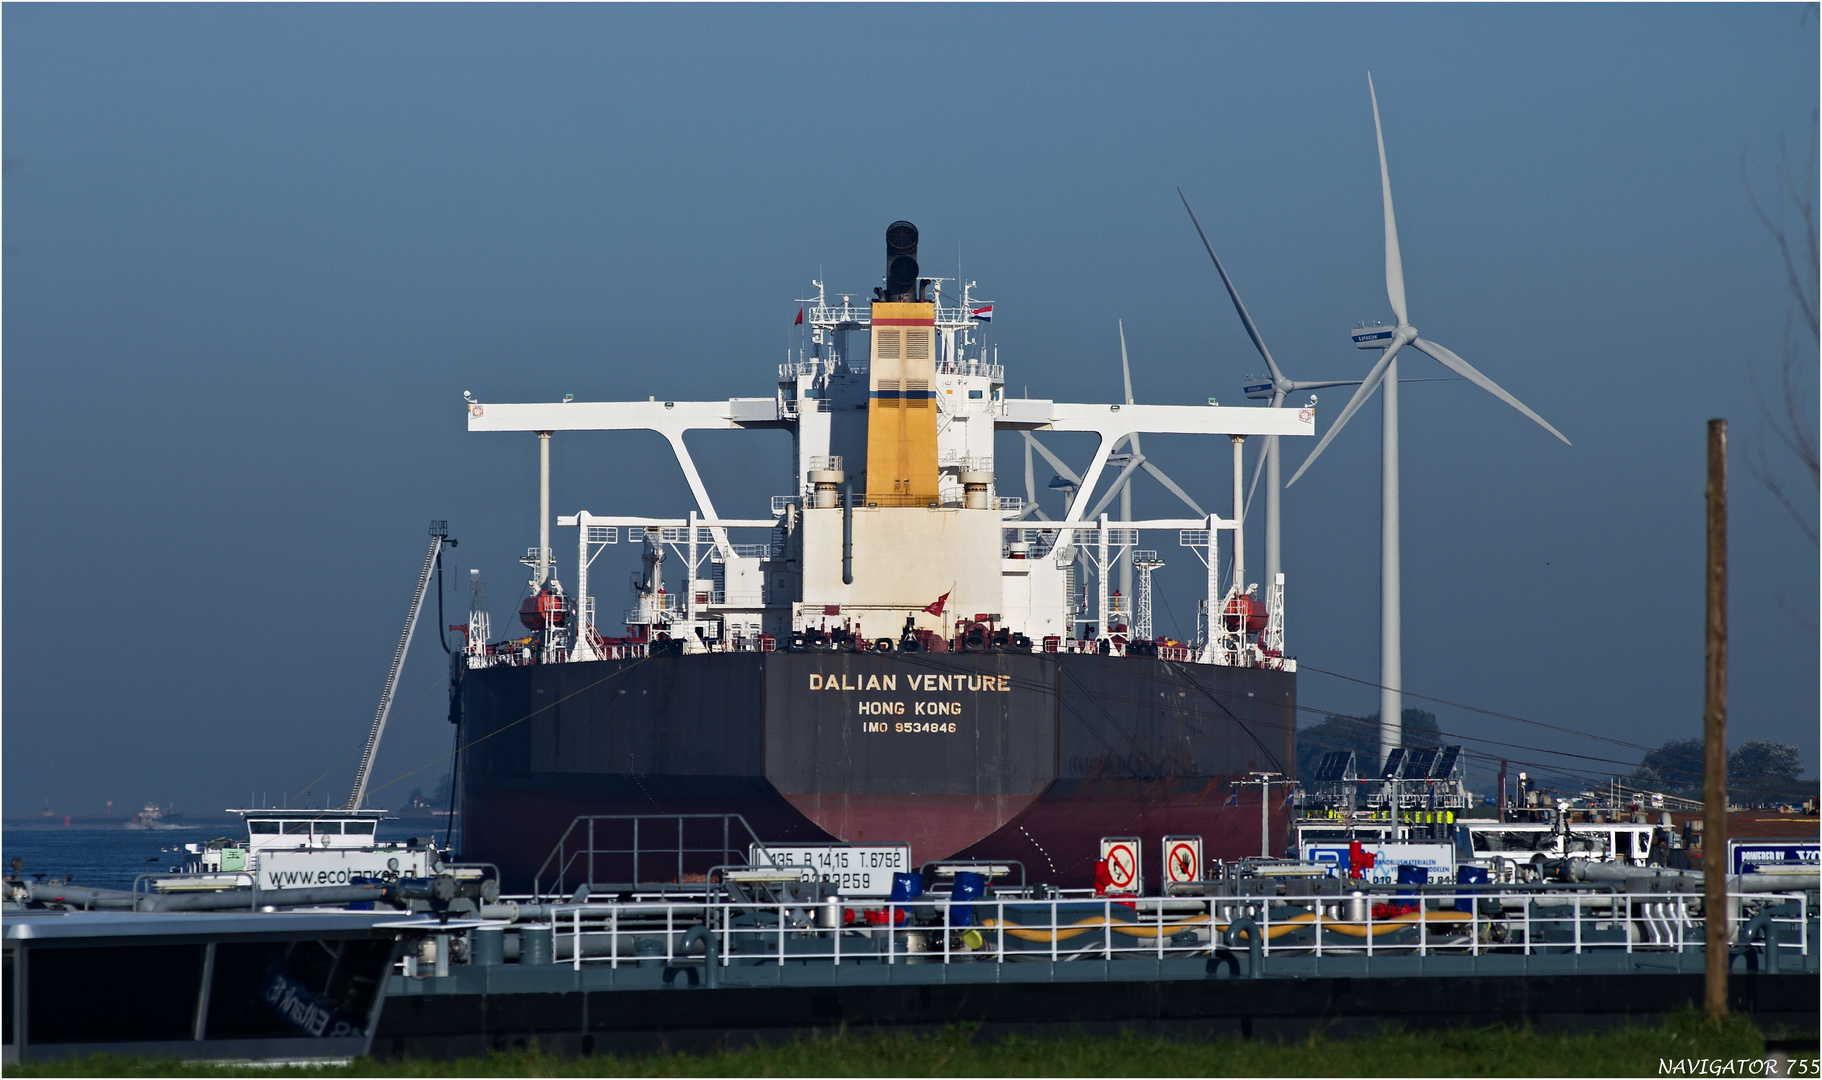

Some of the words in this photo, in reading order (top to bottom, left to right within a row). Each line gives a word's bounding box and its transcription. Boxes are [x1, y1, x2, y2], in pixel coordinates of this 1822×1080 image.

[809, 673, 896, 691] DALIAN
[907, 673, 1011, 692] VENTURE
[858, 701, 905, 716] HONG
[915, 701, 962, 716] KONG
[863, 722, 888, 733] IMO
[895, 722, 957, 733] 9534846
[1741, 851, 1774, 865] POWERED
[1775, 851, 1785, 865] BY
